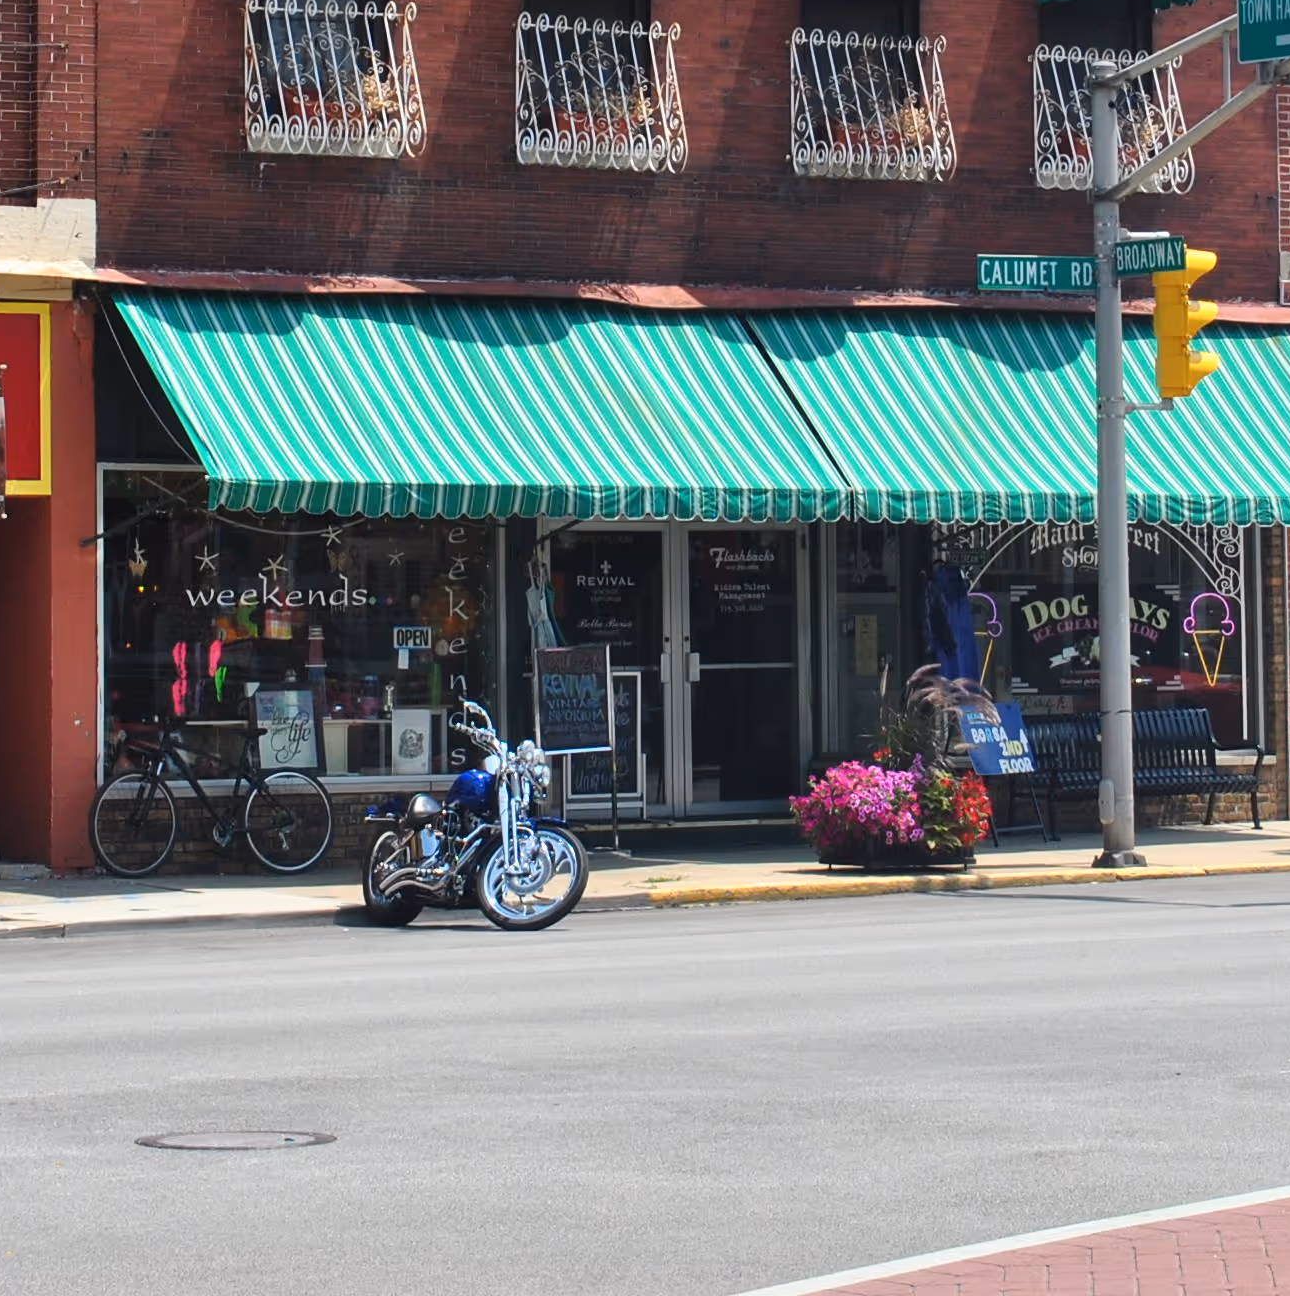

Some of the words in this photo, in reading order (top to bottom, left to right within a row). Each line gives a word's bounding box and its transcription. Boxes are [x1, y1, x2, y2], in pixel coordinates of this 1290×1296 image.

[1116, 240, 1184, 272] BROADWAY
[980, 259, 1059, 286] CALUMET
[1071, 261, 1094, 287] RD
[709, 547, 776, 569] Flashbacks
[185, 572, 369, 608] weekends
[576, 575, 636, 586] REVIVAL
[1020, 594, 1089, 632] DOG
[1129, 596, 1170, 630] AYS
[396, 629, 430, 647] OPEN
[446, 524, 469, 766] eekends
[971, 724, 1009, 744] BORSA
[999, 740, 1024, 757] 2ND
[998, 757, 1035, 775] FLOOR
